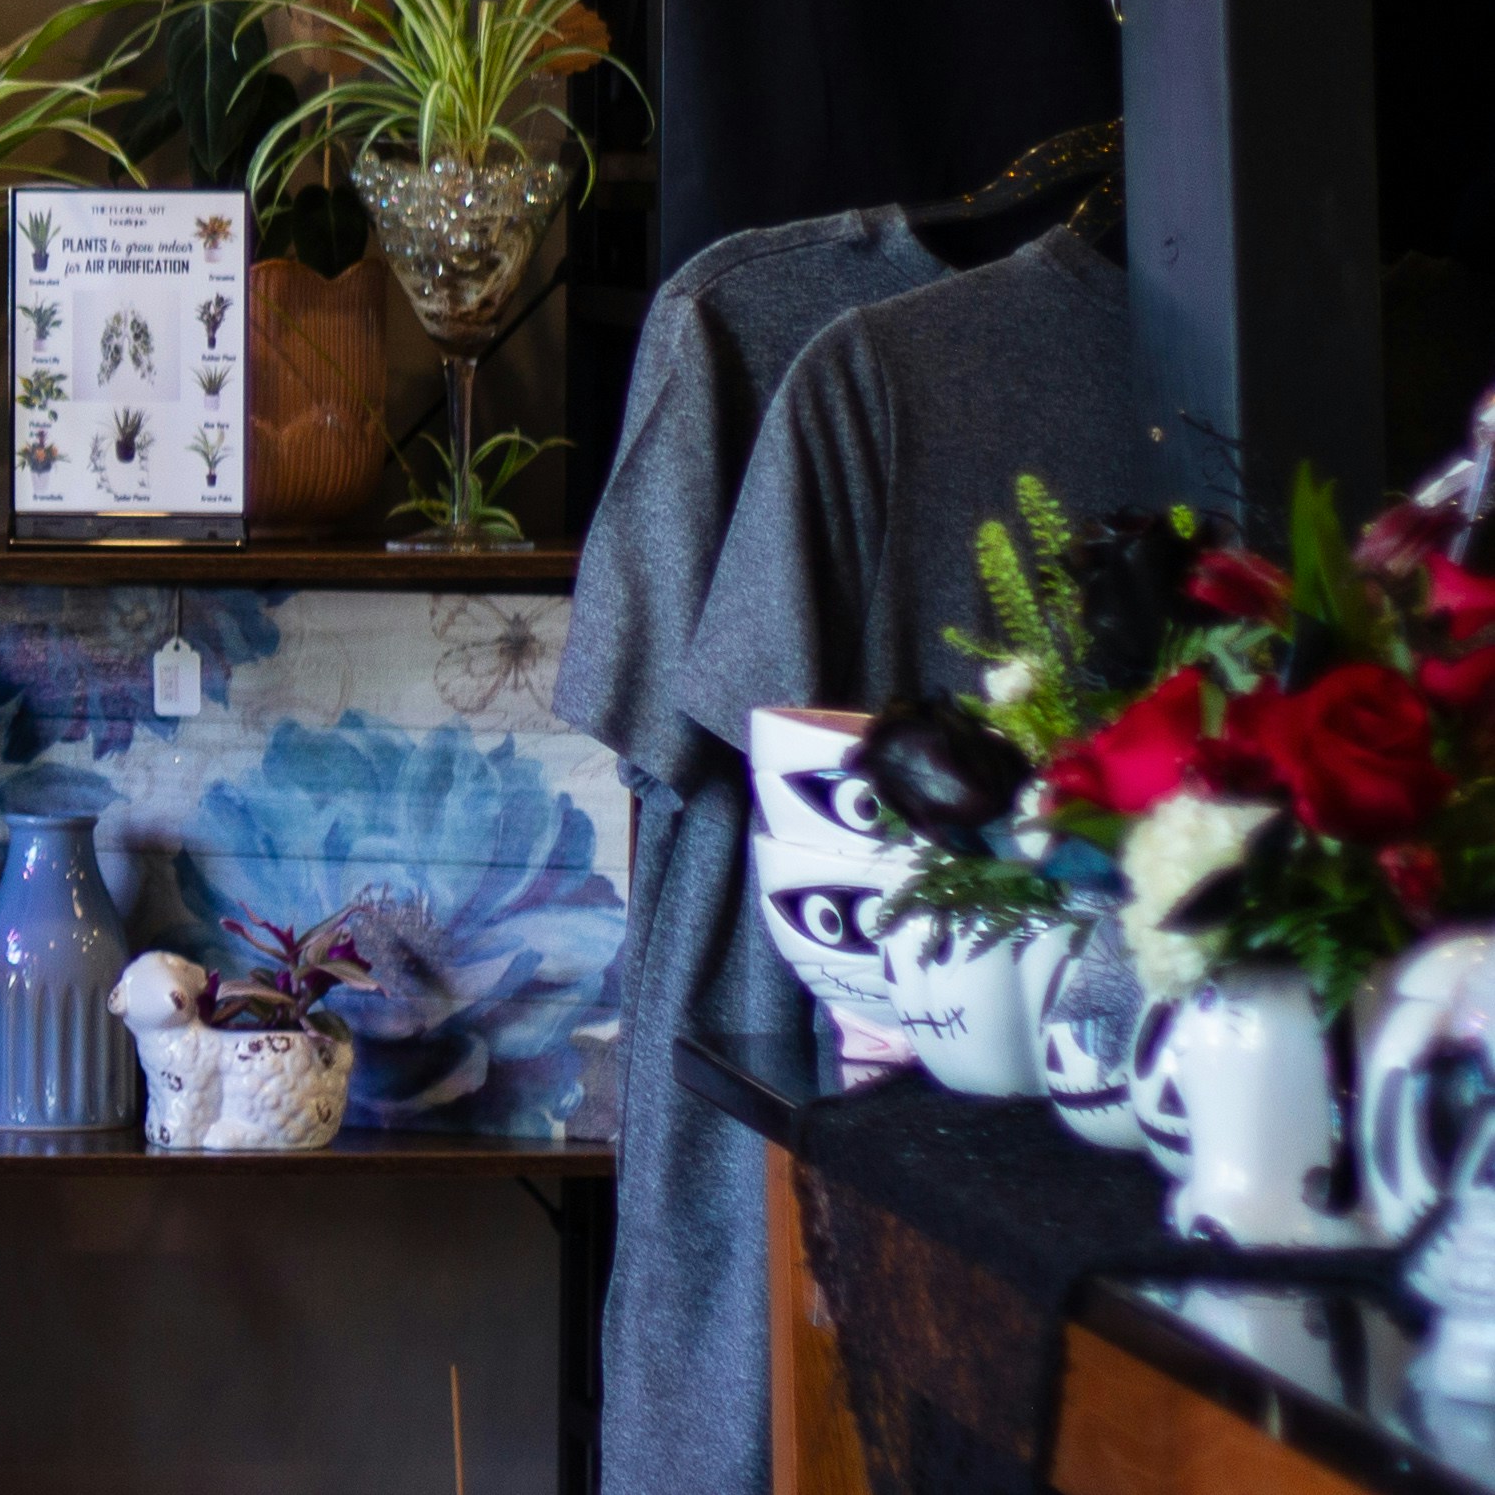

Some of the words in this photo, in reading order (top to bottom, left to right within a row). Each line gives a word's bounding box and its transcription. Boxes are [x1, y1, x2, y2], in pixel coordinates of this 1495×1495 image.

[62, 237, 108, 254] PLANTS
[111, 239, 121, 253] to
[126, 242, 154, 259] grow
[158, 238, 194, 254] indoor
[64, 261, 81, 279] for
[85, 259, 105, 275] AIR
[108, 258, 190, 275] PURIFICATION
